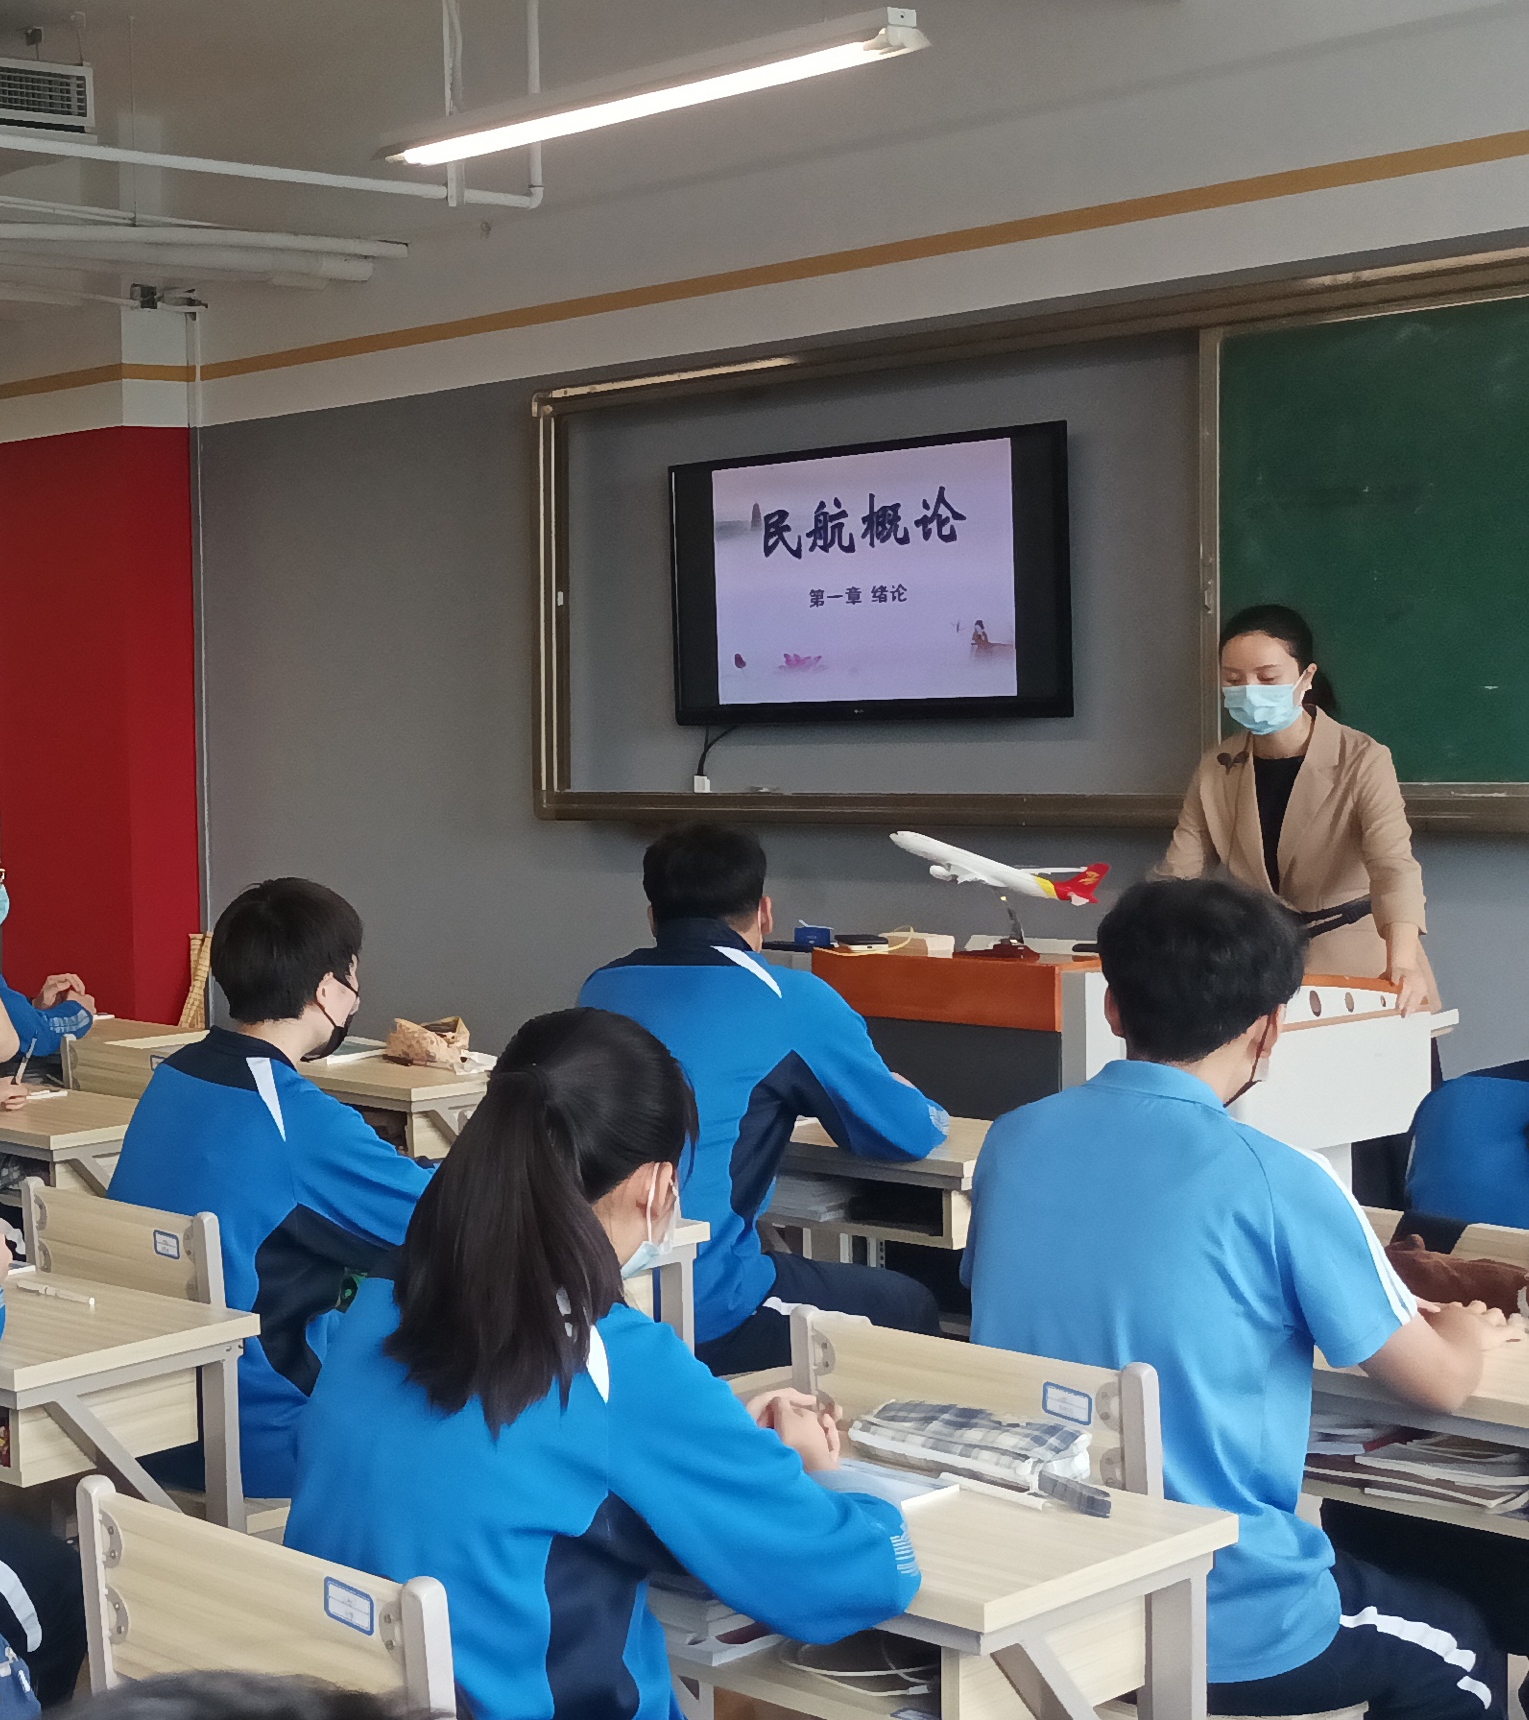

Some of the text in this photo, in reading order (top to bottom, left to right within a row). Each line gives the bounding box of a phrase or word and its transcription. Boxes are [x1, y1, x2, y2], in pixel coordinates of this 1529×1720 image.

[762, 486, 967, 560] 民航概论
[808, 583, 909, 609] 第一章 绪论
